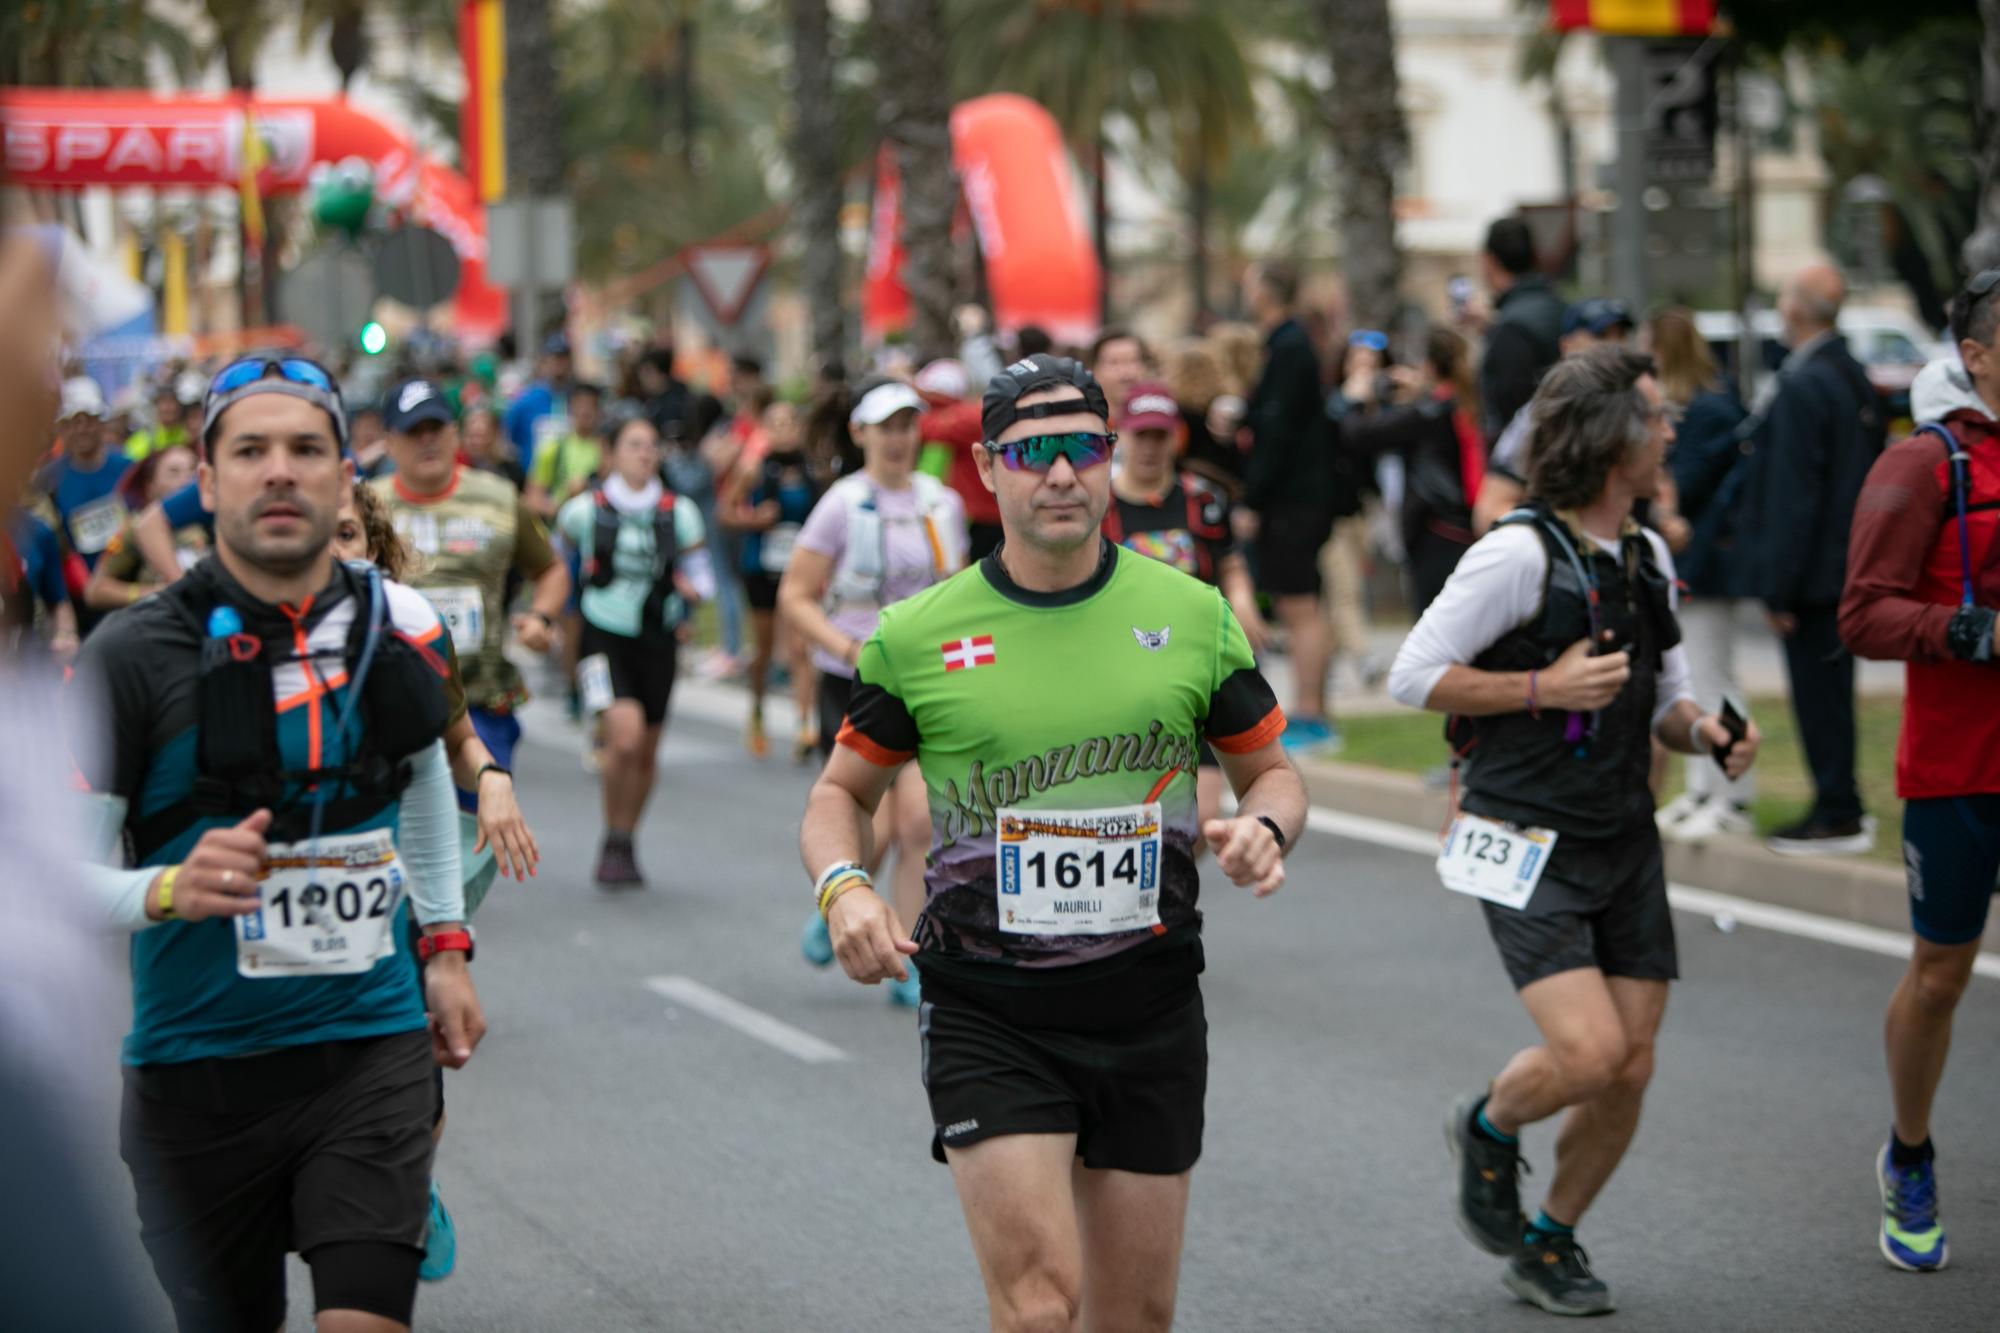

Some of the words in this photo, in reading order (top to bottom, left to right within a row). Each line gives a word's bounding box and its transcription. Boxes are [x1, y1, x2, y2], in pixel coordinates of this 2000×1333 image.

[4, 122, 221, 173] SPAR
[1097, 820, 1137, 837] 2023
[1464, 829, 1512, 865] 123
[1027, 847, 1138, 889] 1614
[1053, 899, 1102, 914] MAURILLI
